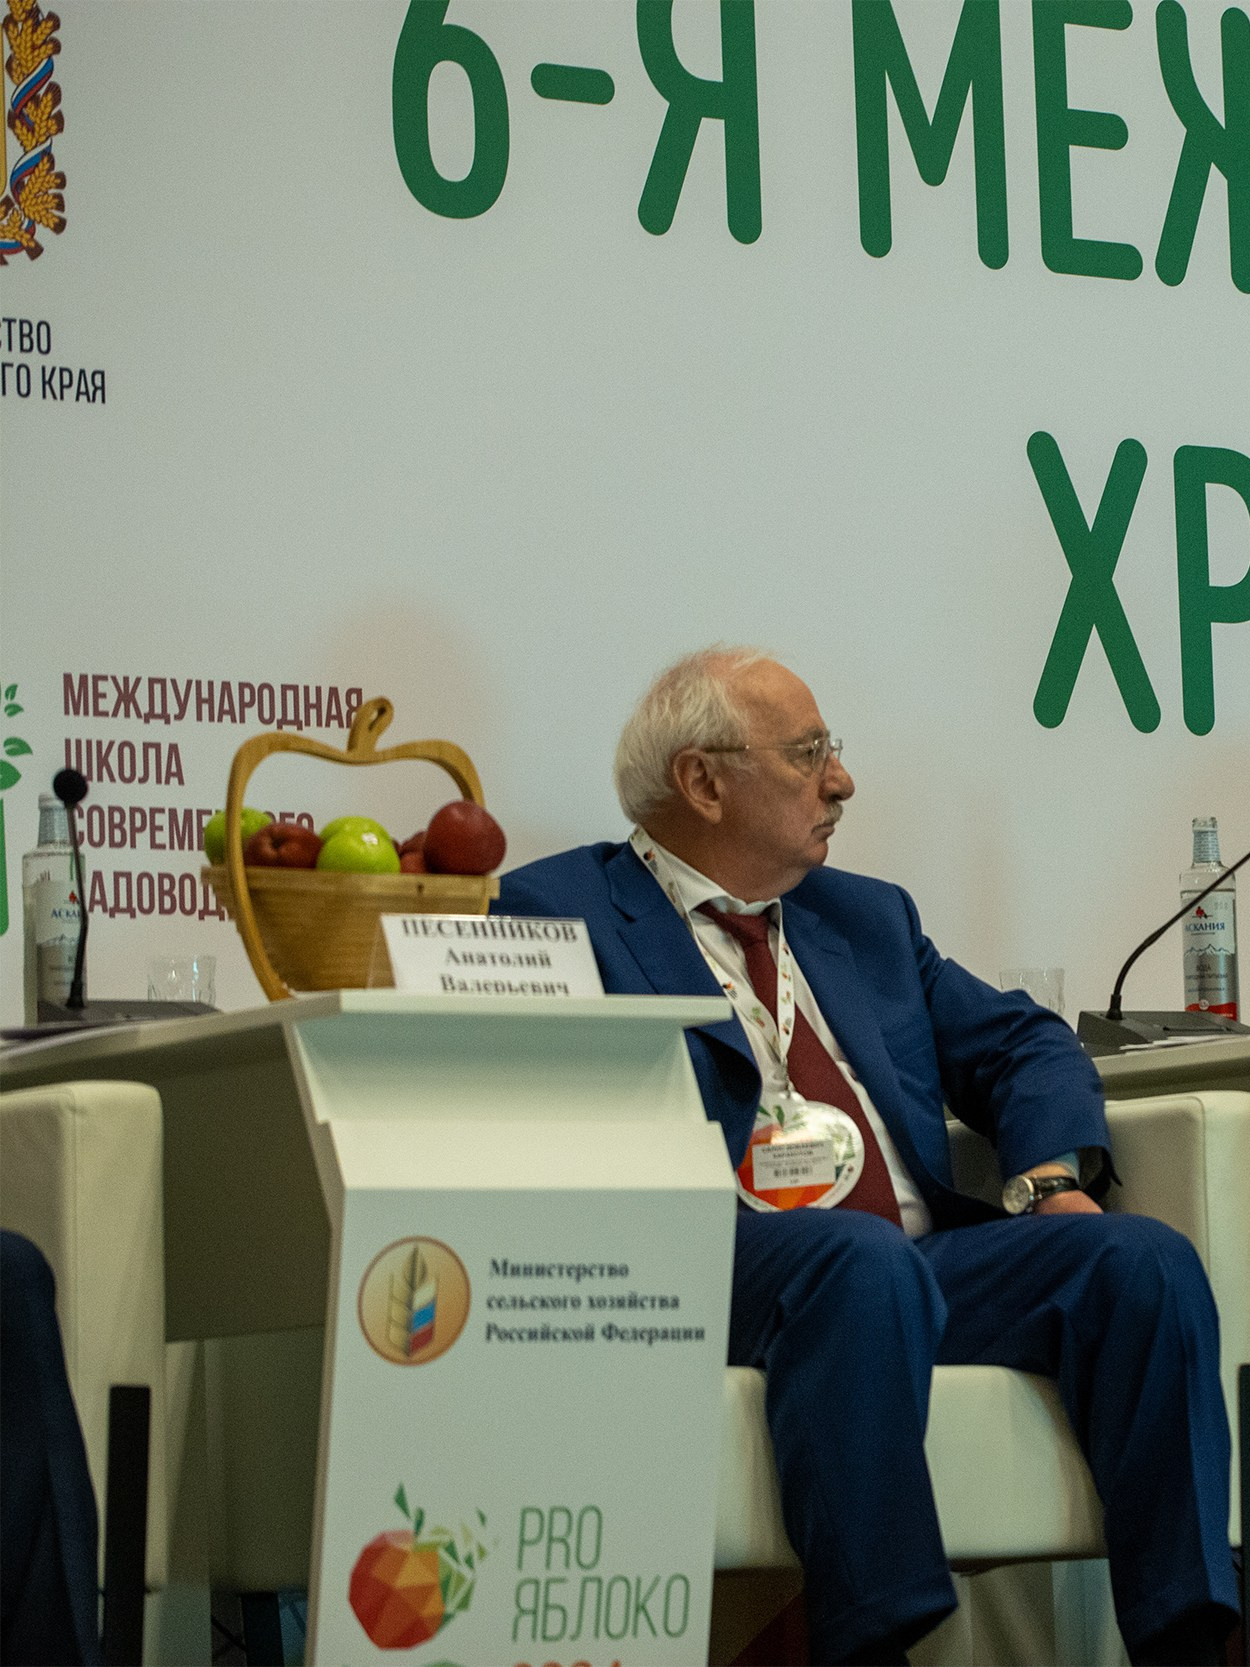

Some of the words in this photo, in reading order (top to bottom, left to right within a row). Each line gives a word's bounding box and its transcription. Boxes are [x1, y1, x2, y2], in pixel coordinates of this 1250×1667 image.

[392, 0, 763, 245] 6-Я
[0, 317, 51, 355] ТВО
[0, 362, 31, 398] ГО
[41, 364, 106, 404] КРАЯ
[62, 672, 363, 731] МЕЖДУНАРОДНАЯ
[64, 737, 185, 786] ШКОЛА
[401, 918, 579, 943] ПЕСЕННИКОВ
[446, 948, 552, 968] Анатолий
[440, 973, 570, 996] Валерьевич
[488, 1258, 630, 1283] Министерство
[486, 1292, 582, 1312] сельского
[586, 1291, 680, 1311] хозяйства
[485, 1322, 597, 1344] Российской
[600, 1322, 706, 1346] Федерации
[516, 1504, 603, 1571] PRO
[511, 1573, 691, 1643] ЯБЛОКО
